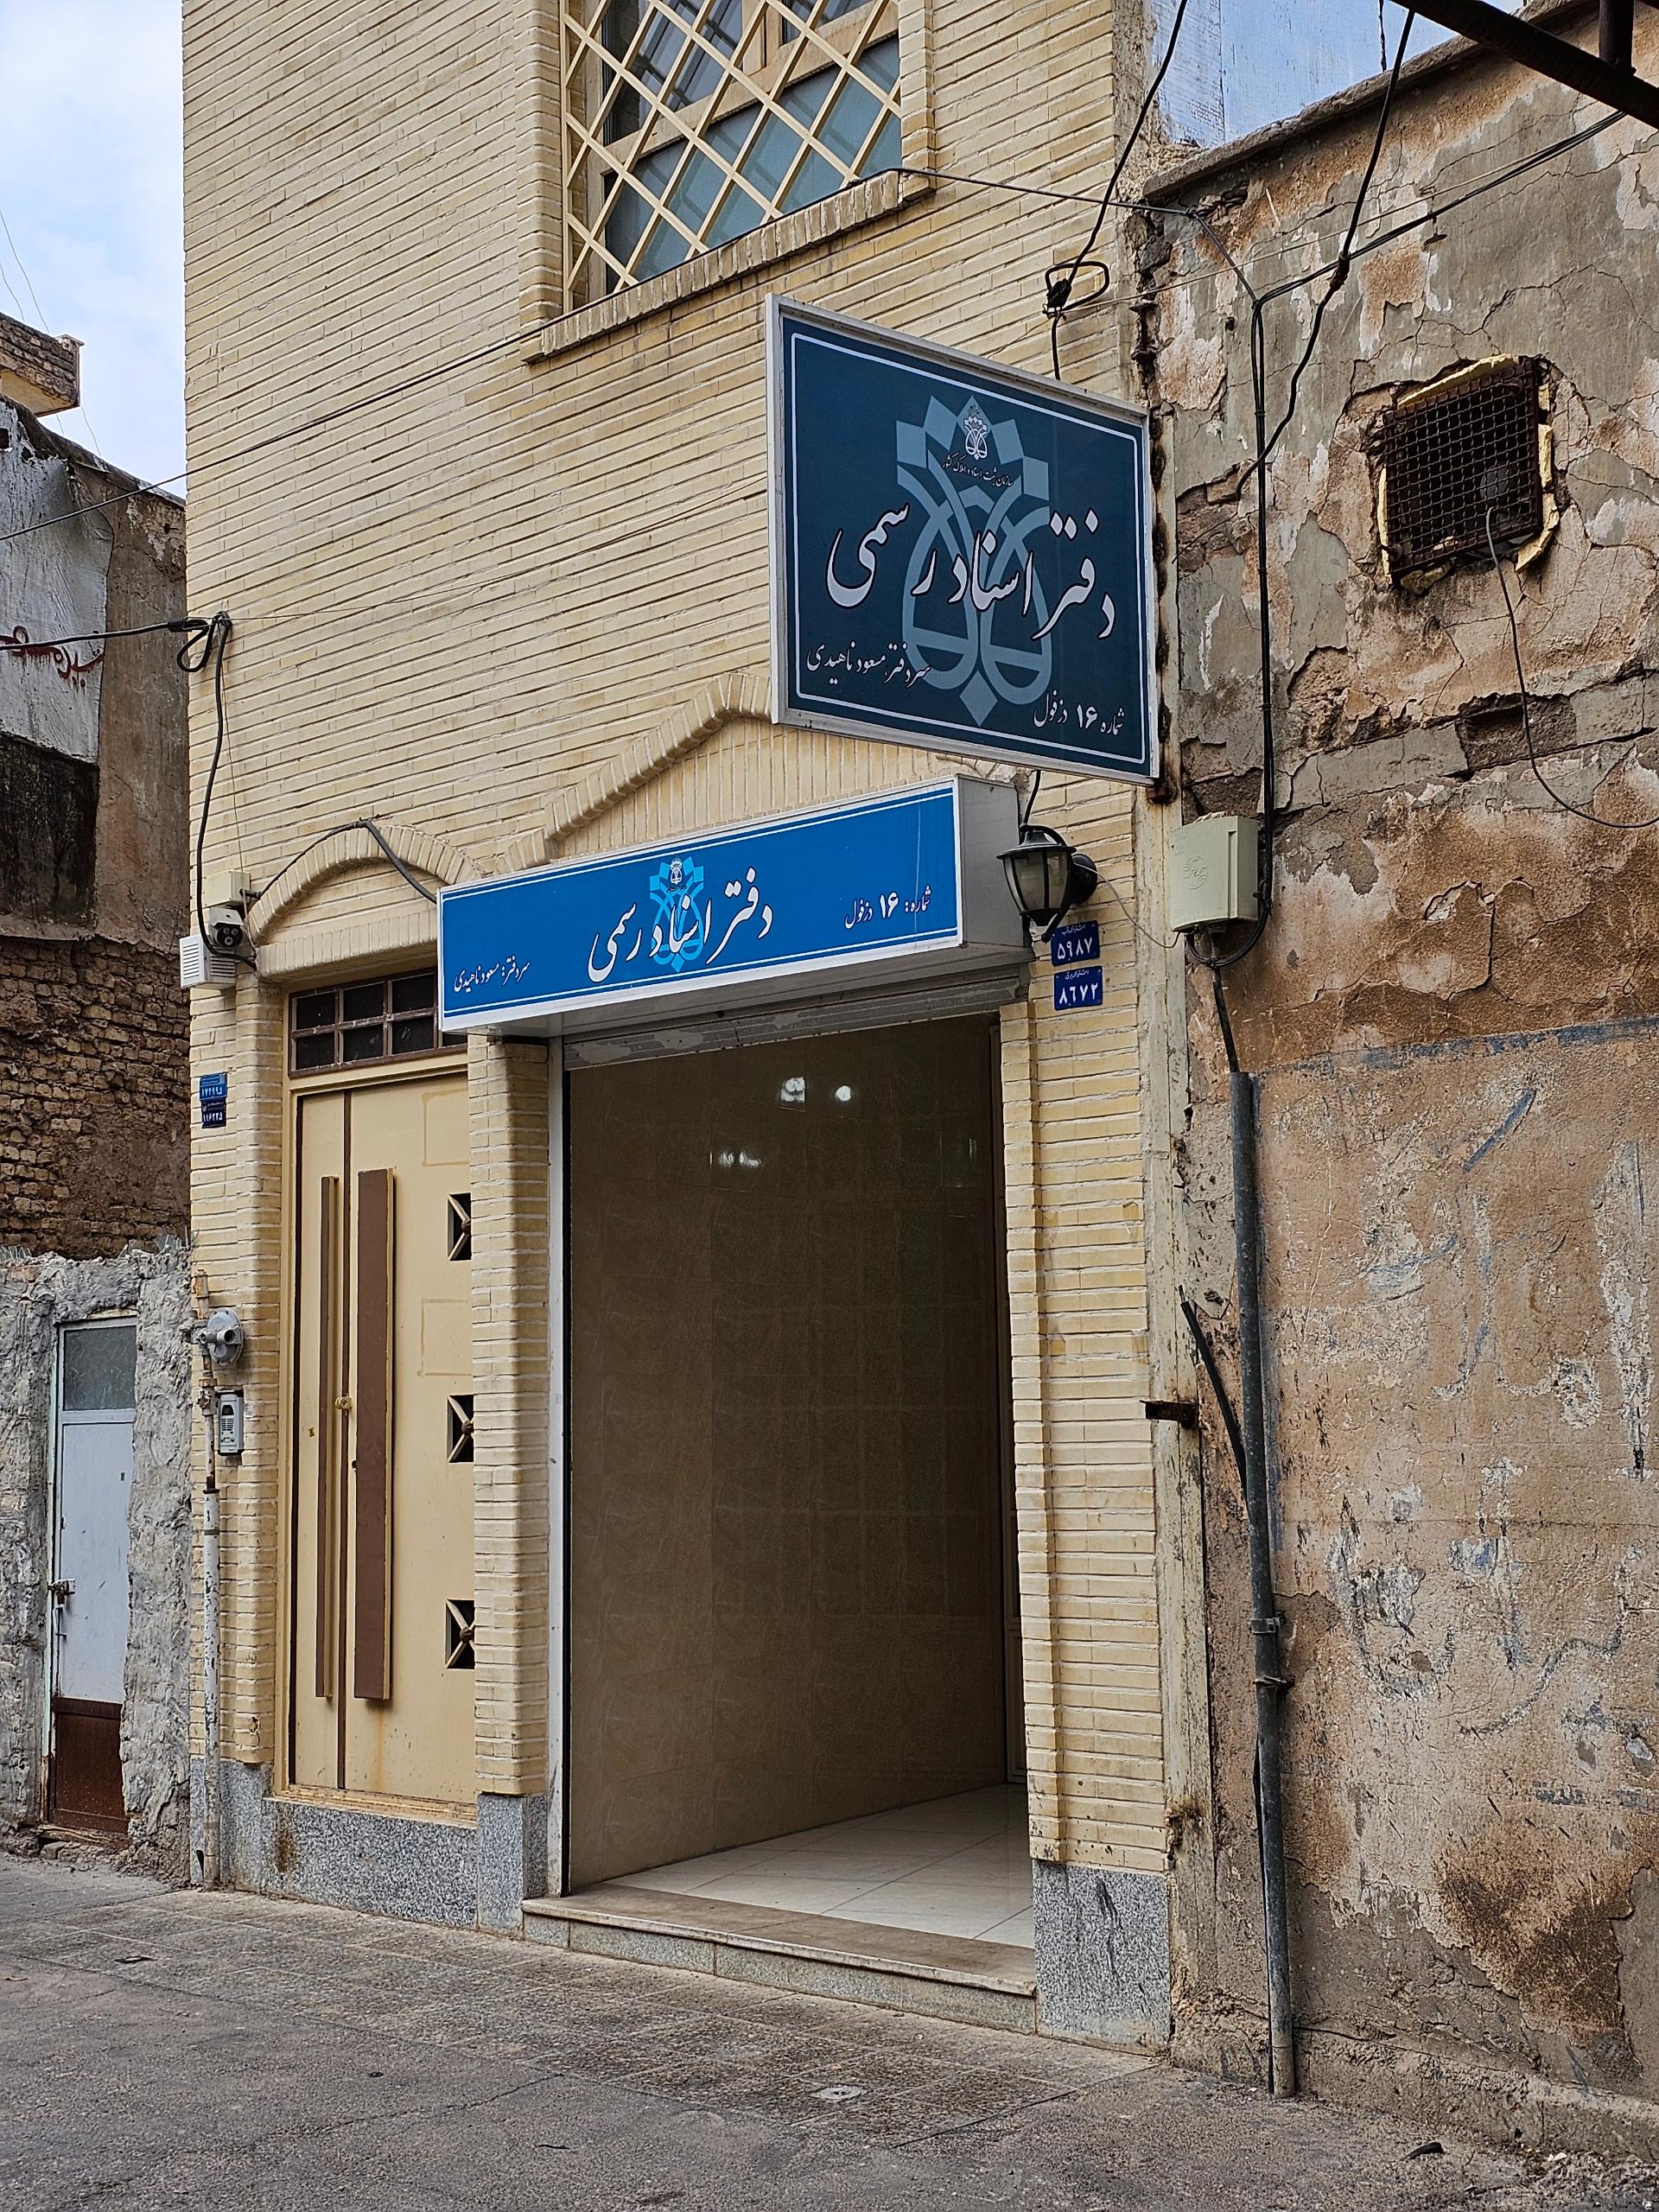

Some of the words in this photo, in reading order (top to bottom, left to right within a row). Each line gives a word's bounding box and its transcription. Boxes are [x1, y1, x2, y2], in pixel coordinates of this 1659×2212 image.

[826, 503, 937, 608] رسمی
[947, 530, 1034, 616] اسناد
[1031, 507, 1116, 640] دفتر
[806, 640, 856, 685] ناهیدی
[856, 654, 887, 675] مسعود
[1033, 689, 1068, 728] دزفول
[1077, 703, 1098, 729] ۱۶
[1100, 707, 1125, 736] شماره
[705, 867, 774, 965] دفتر
[845, 899, 873, 930] دزفول
[880, 892, 899, 919] ۱۶
[587, 902, 643, 983] رسمی
[648, 893, 713, 959] اسناد
[1058, 937, 1092, 959] ۵۹۸۷
[454, 964, 482, 994] ناهیدی
[480, 963, 500, 985] مسعود
